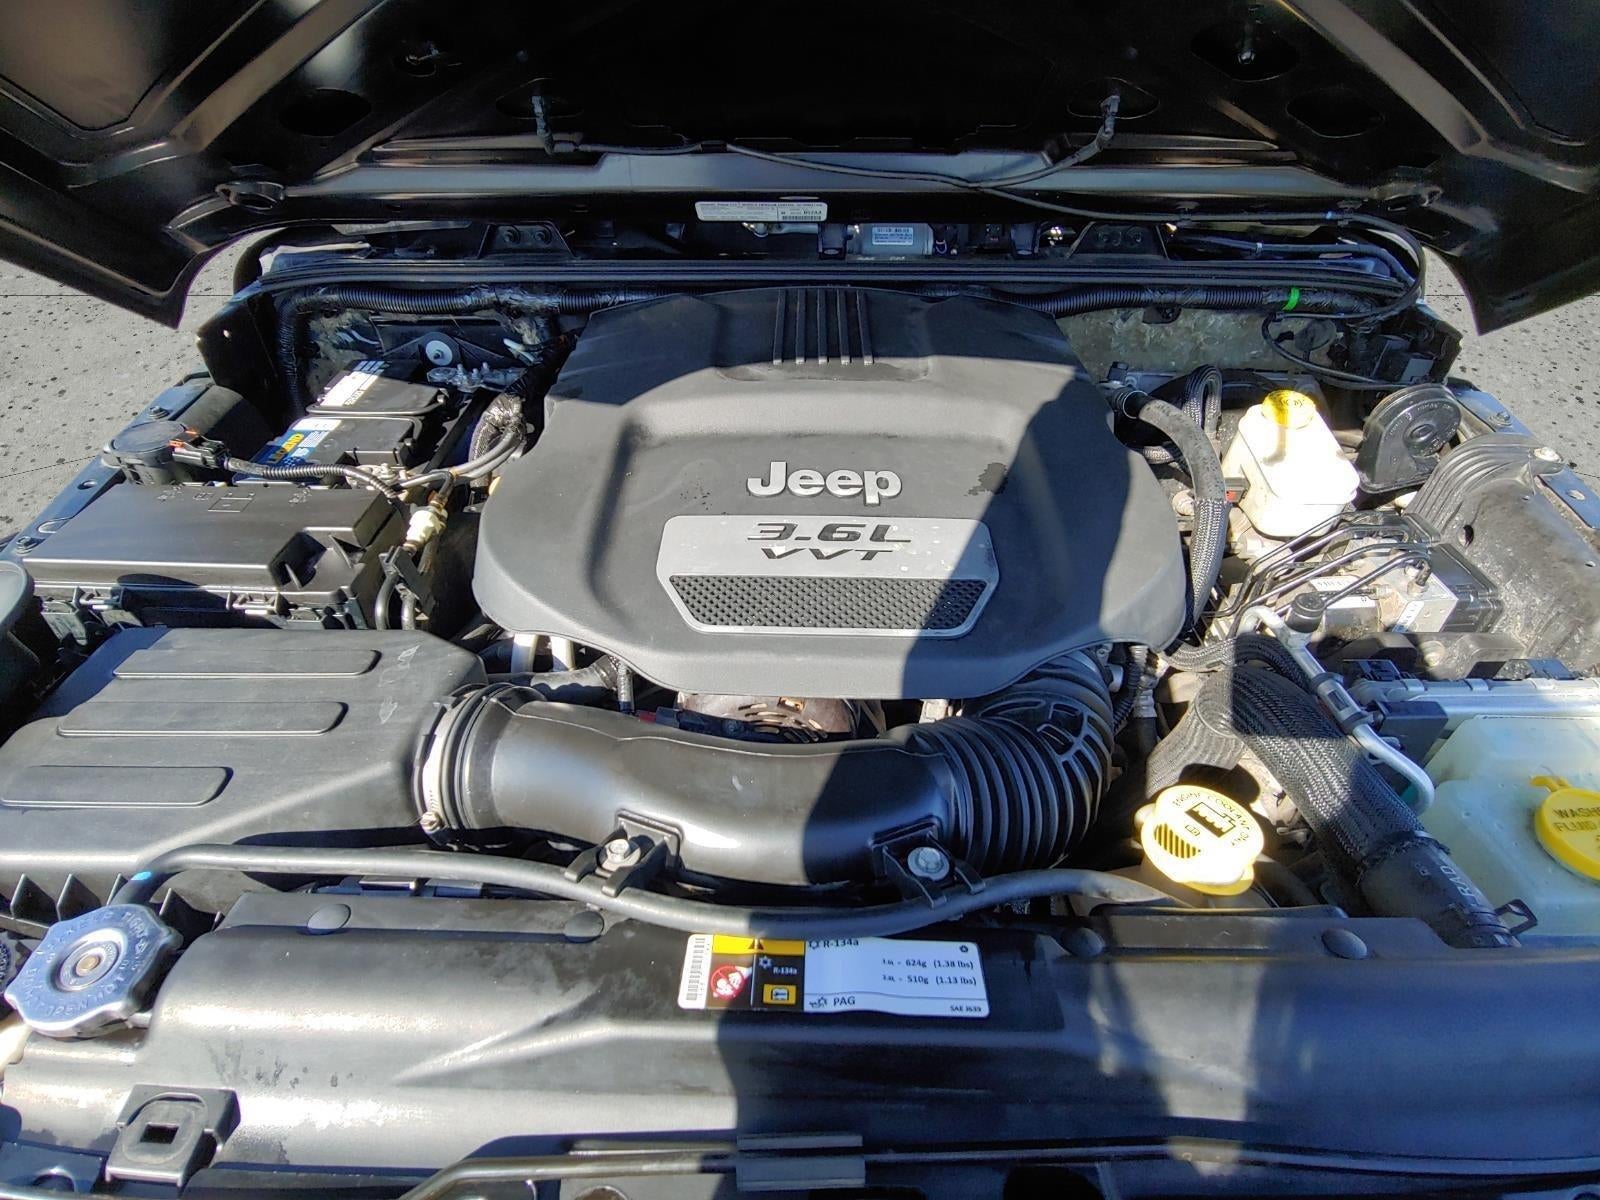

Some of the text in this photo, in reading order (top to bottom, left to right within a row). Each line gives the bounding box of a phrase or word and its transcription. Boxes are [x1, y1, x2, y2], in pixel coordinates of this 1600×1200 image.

[746, 460, 902, 506] Jeep
[746, 521, 912, 543] 3.6L
[760, 547, 894, 561] VVT
[823, 939, 859, 949] R-134a
[905, 959, 928, 968] 624g
[773, 966, 798, 975] R-134a
[907, 975, 930, 985] 510g
[833, 997, 856, 1007] PAG
